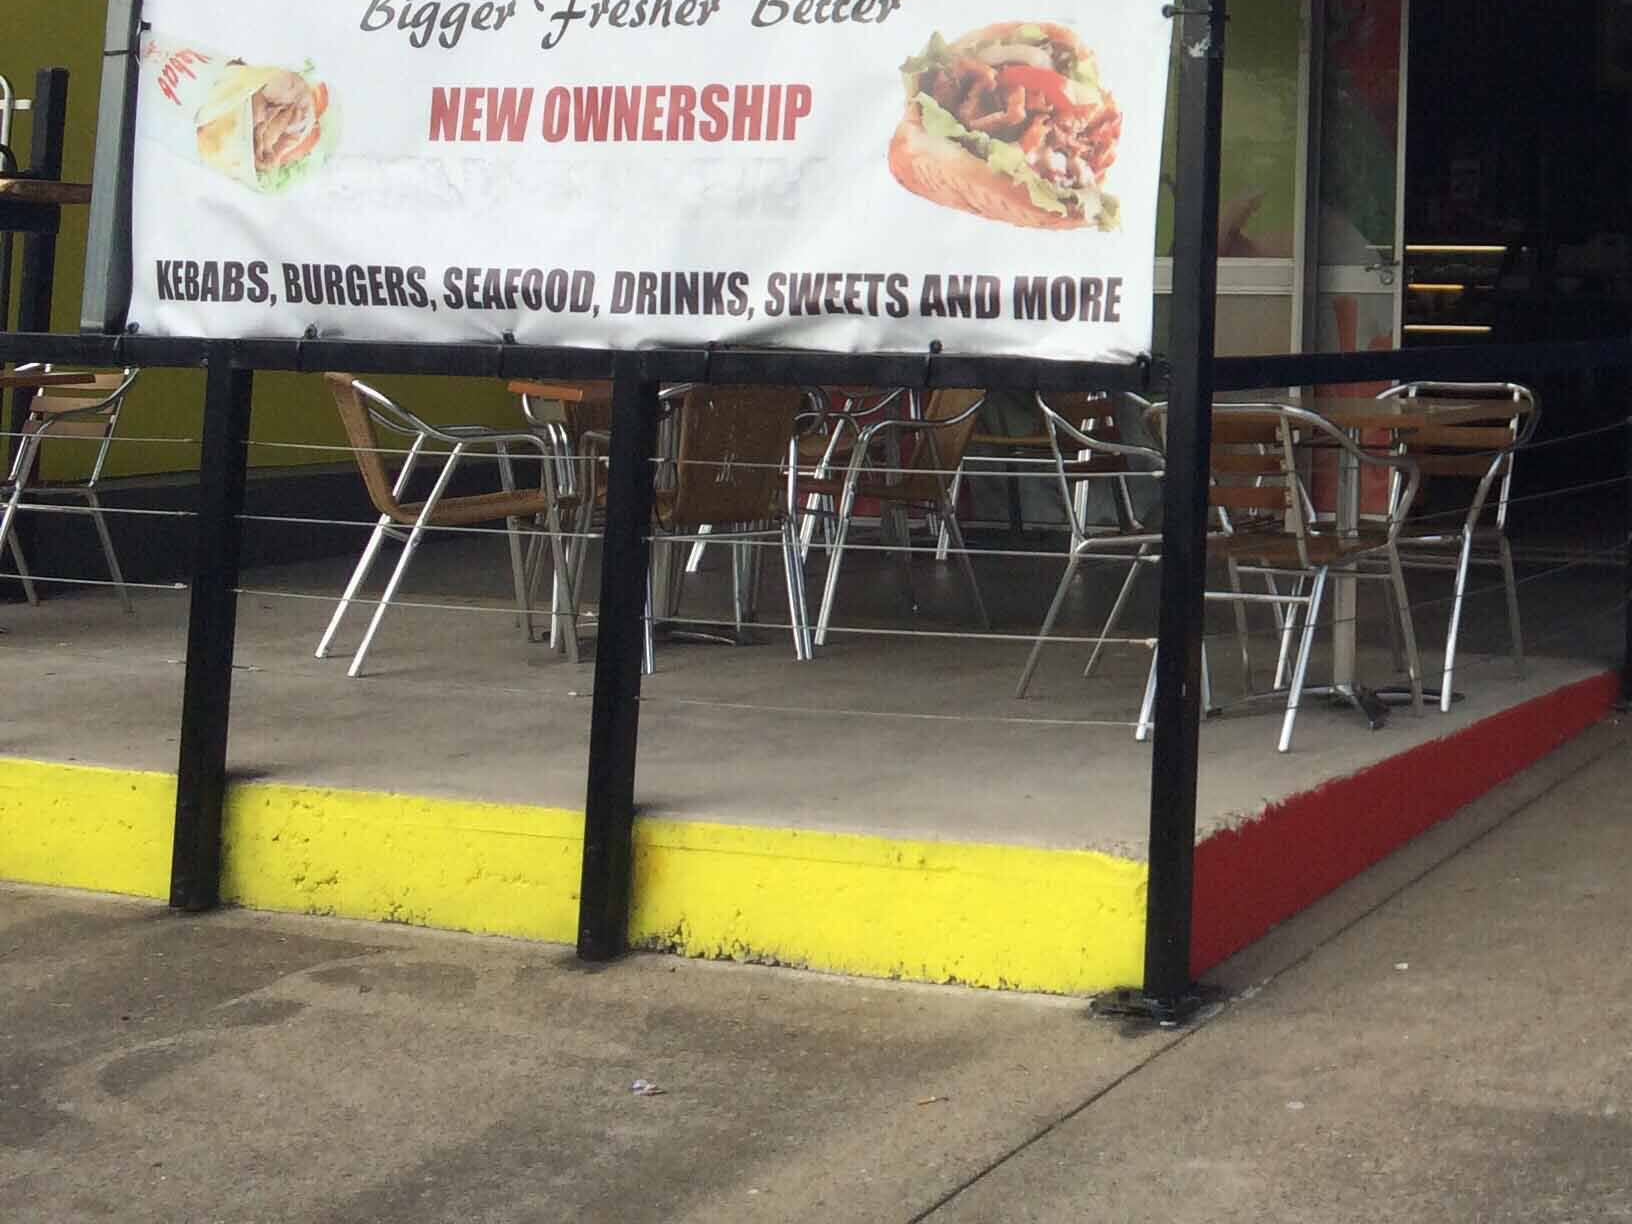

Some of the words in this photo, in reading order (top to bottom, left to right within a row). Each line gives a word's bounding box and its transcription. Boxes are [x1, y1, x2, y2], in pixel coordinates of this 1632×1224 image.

[428, 86, 533, 143] NEW
[542, 83, 812, 143] OWNERSHIP
[156, 260, 277, 308] KEBABS,
[282, 262, 437, 313] BURGERS,
[443, 266, 599, 319] SEAFOOD,
[609, 271, 754, 321] DRINKS,
[764, 272, 908, 318] SWEETS
[920, 274, 1001, 320] AND
[1013, 276, 1122, 323] MORE
